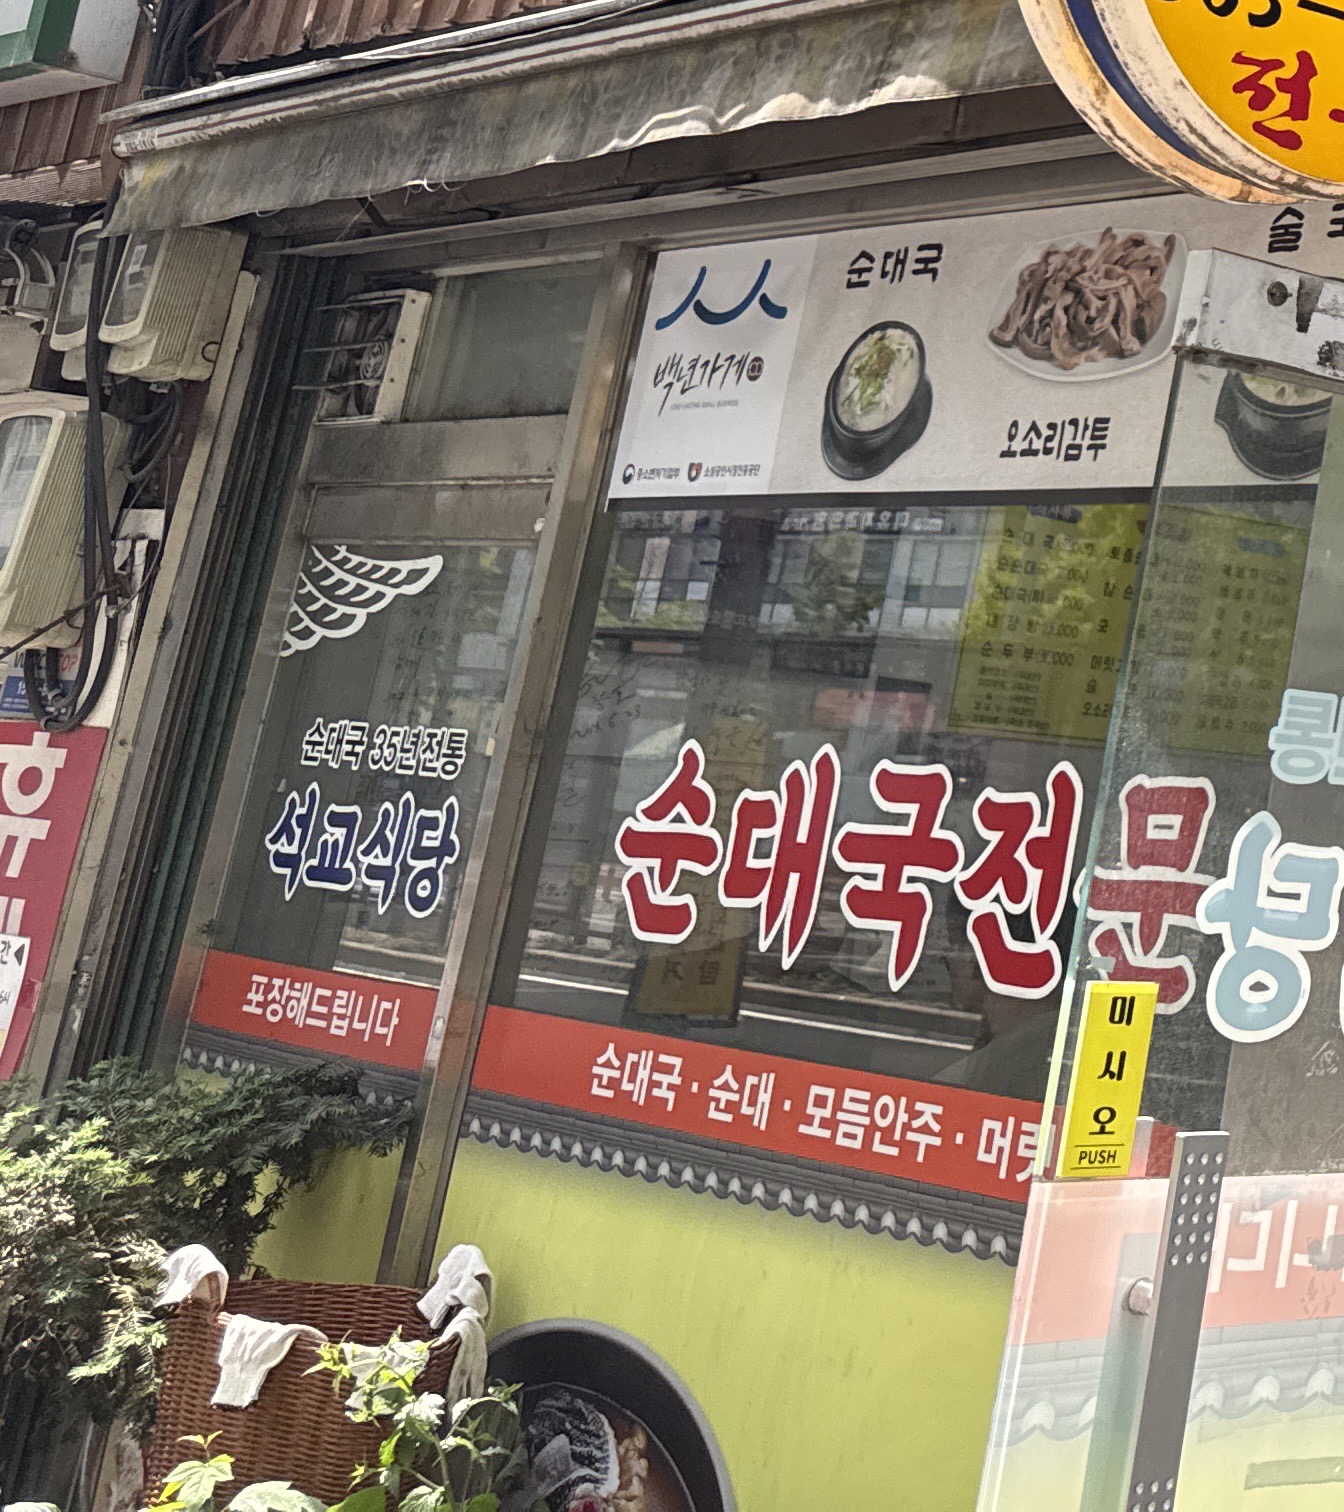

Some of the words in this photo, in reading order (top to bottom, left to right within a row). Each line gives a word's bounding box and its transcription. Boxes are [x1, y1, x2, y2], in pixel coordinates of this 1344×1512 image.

[845, 243, 945, 288] 순대국
[654, 351, 750, 416] 백년가게
[999, 416, 1111, 463] 오소리감투
[300, 718, 370, 771] 순대국
[368, 723, 468, 780] 35년전통
[265, 781, 461, 919] 석교식당
[242, 974, 402, 1047] 포장해드립니다
[590, 1042, 684, 1113] 순대국
[706, 1063, 778, 1132] 순대
[797, 1084, 946, 1164] 모듬안주
[1077, 1147, 1119, 1168] PUSH
